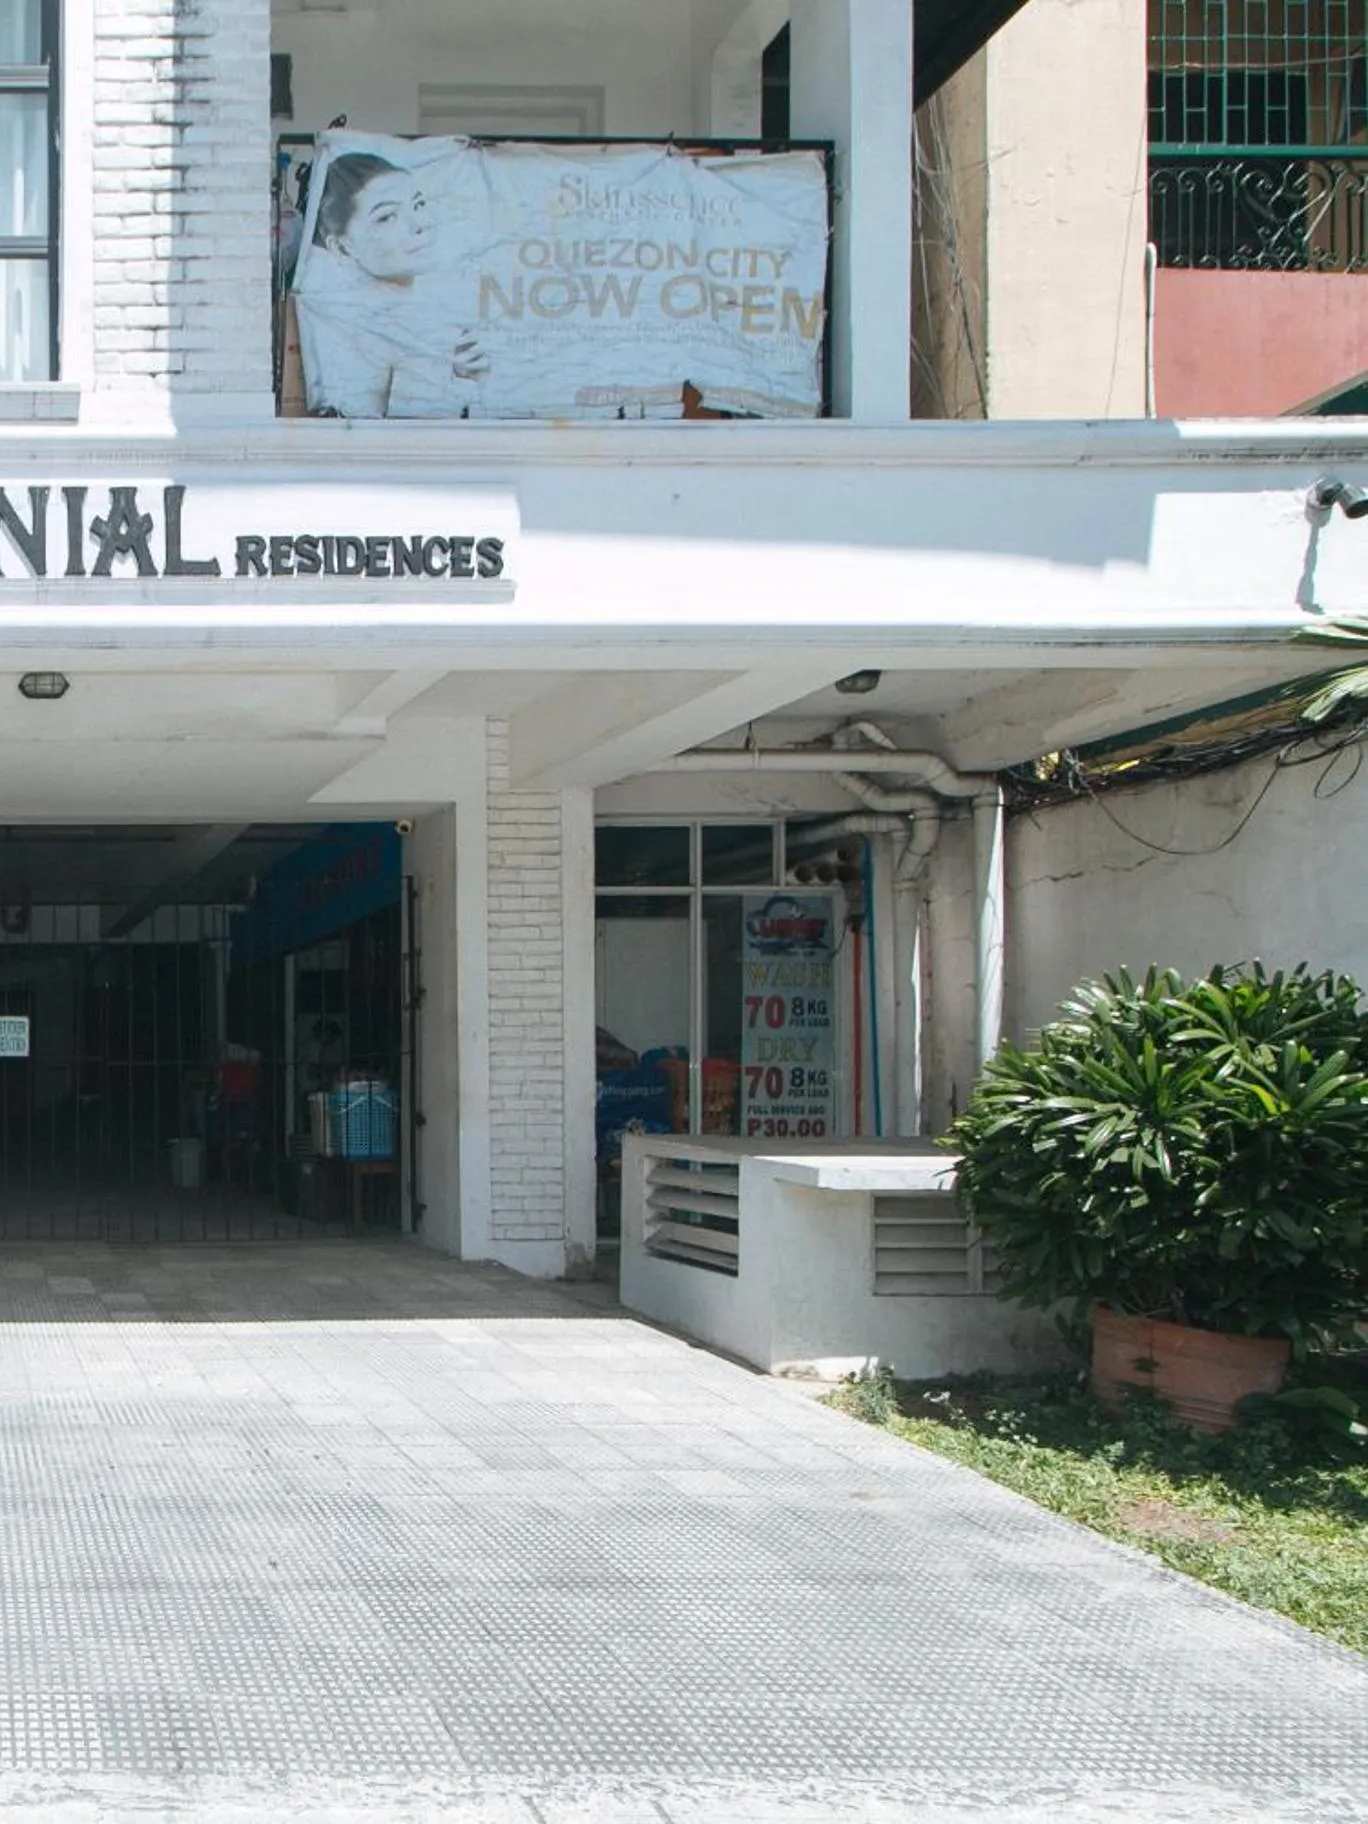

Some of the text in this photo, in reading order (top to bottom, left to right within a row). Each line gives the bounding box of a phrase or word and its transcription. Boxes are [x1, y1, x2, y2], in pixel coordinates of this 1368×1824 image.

[518, 238, 792, 278] QUEZON CITY
[477, 274, 643, 320] NOW
[659, 274, 823, 339] OPEN
[236, 535, 505, 579] RESIDENCES
[744, 995, 828, 1029] 70 8 KG
[756, 1036, 818, 1062] DRY
[744, 1066, 828, 1099] 70 8 KG
[747, 1118, 826, 1138] P30.00
